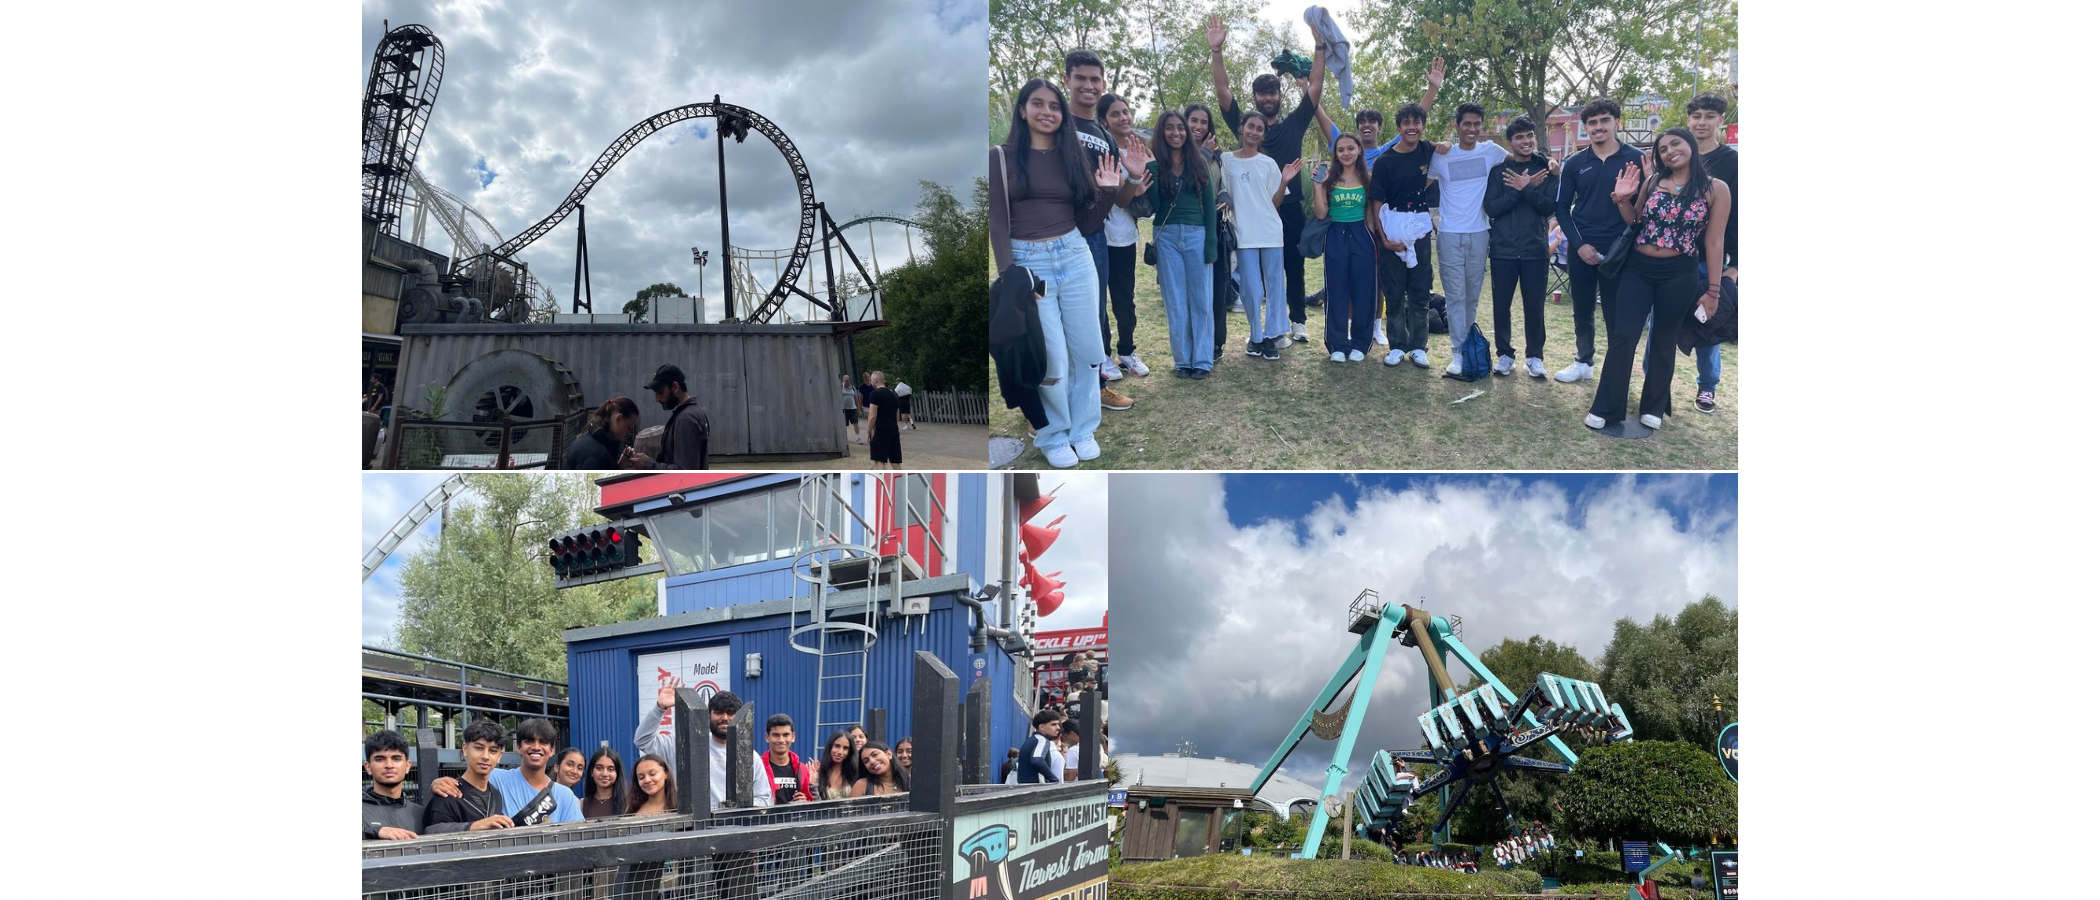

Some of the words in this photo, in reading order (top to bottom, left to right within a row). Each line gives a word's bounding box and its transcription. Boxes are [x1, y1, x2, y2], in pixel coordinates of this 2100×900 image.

[1082, 141, 1109, 153] JONE
[1334, 193, 1362, 202] BRASIL
[694, 662, 719, 676] Model
[1018, 845, 1073, 894] Newest
